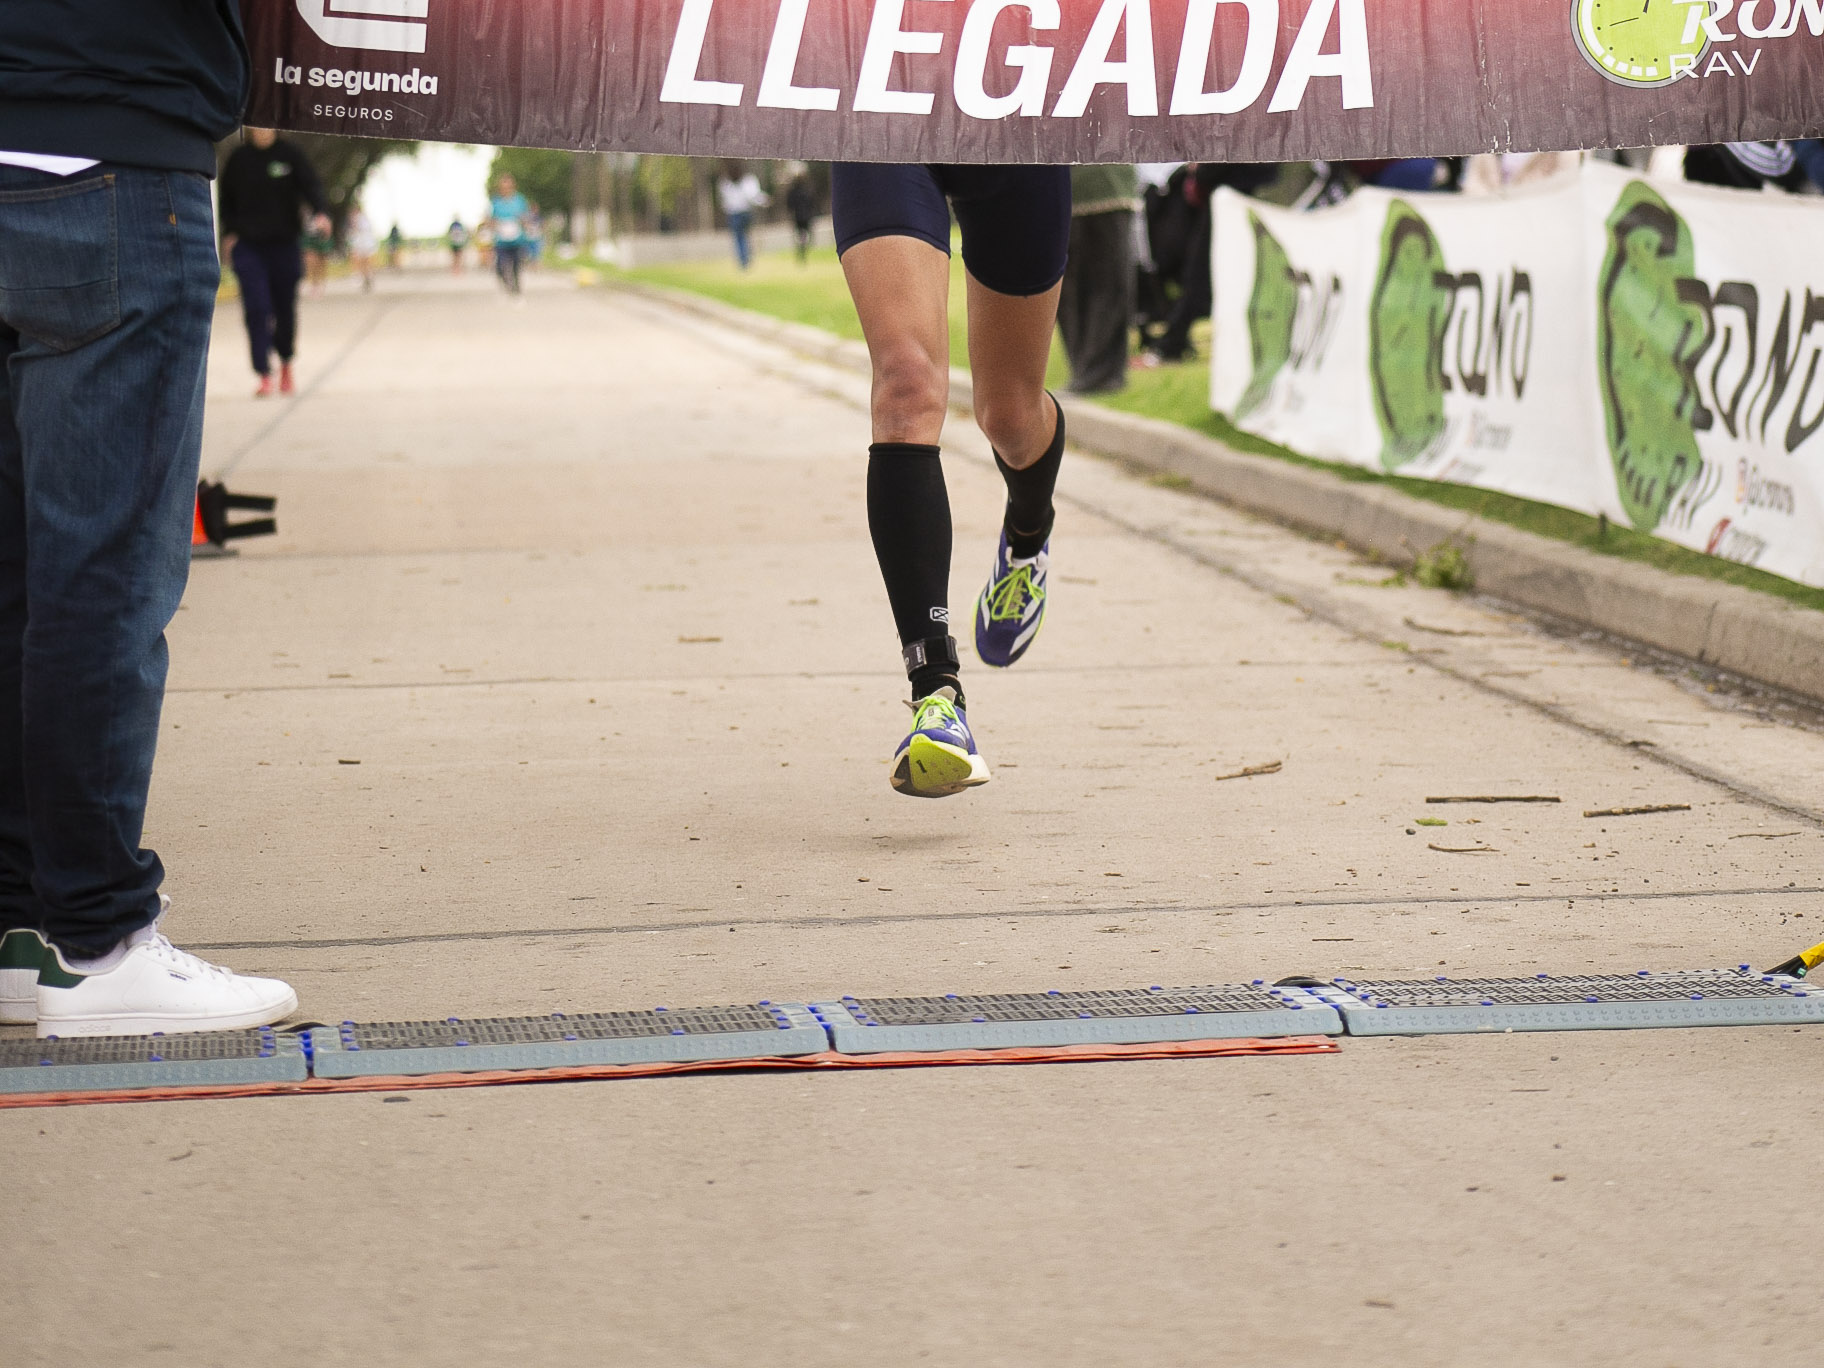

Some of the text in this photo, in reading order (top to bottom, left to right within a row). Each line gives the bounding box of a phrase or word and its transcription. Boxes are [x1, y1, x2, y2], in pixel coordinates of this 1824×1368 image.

[274, 57, 438, 96] la segunda
[1669, 48, 1762, 80] RAV
[313, 104, 394, 121] SEGUROS
